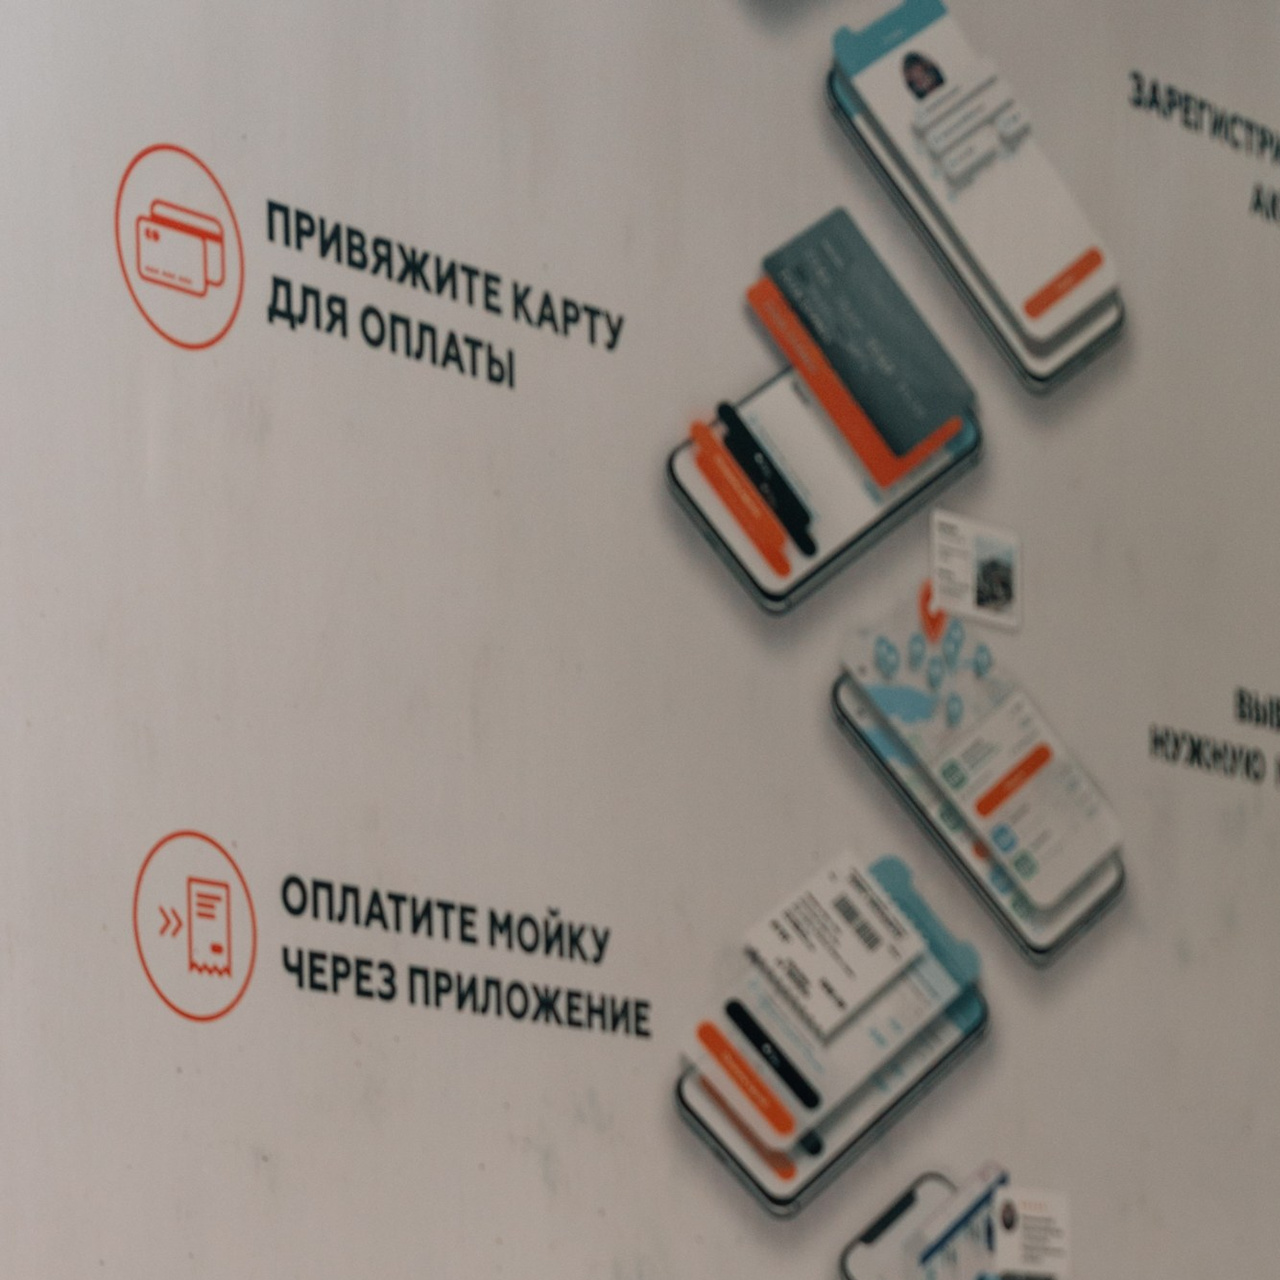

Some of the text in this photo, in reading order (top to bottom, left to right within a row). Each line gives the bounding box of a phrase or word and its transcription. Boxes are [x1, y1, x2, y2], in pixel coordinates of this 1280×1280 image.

[266, 199, 624, 352] ПРИВЯЖИТЕ КАРТУ
[267, 275, 515, 388] ДЛЯ ОПЛАТЫ
[1150, 726, 1266, 785] НУЖНУЮ
[281, 874, 610, 964] ОПЛАТИТЕ МОЙКУ
[282, 946, 652, 1038] ЧЕРЕЗ ПРИЛОЖЕНИЕ
